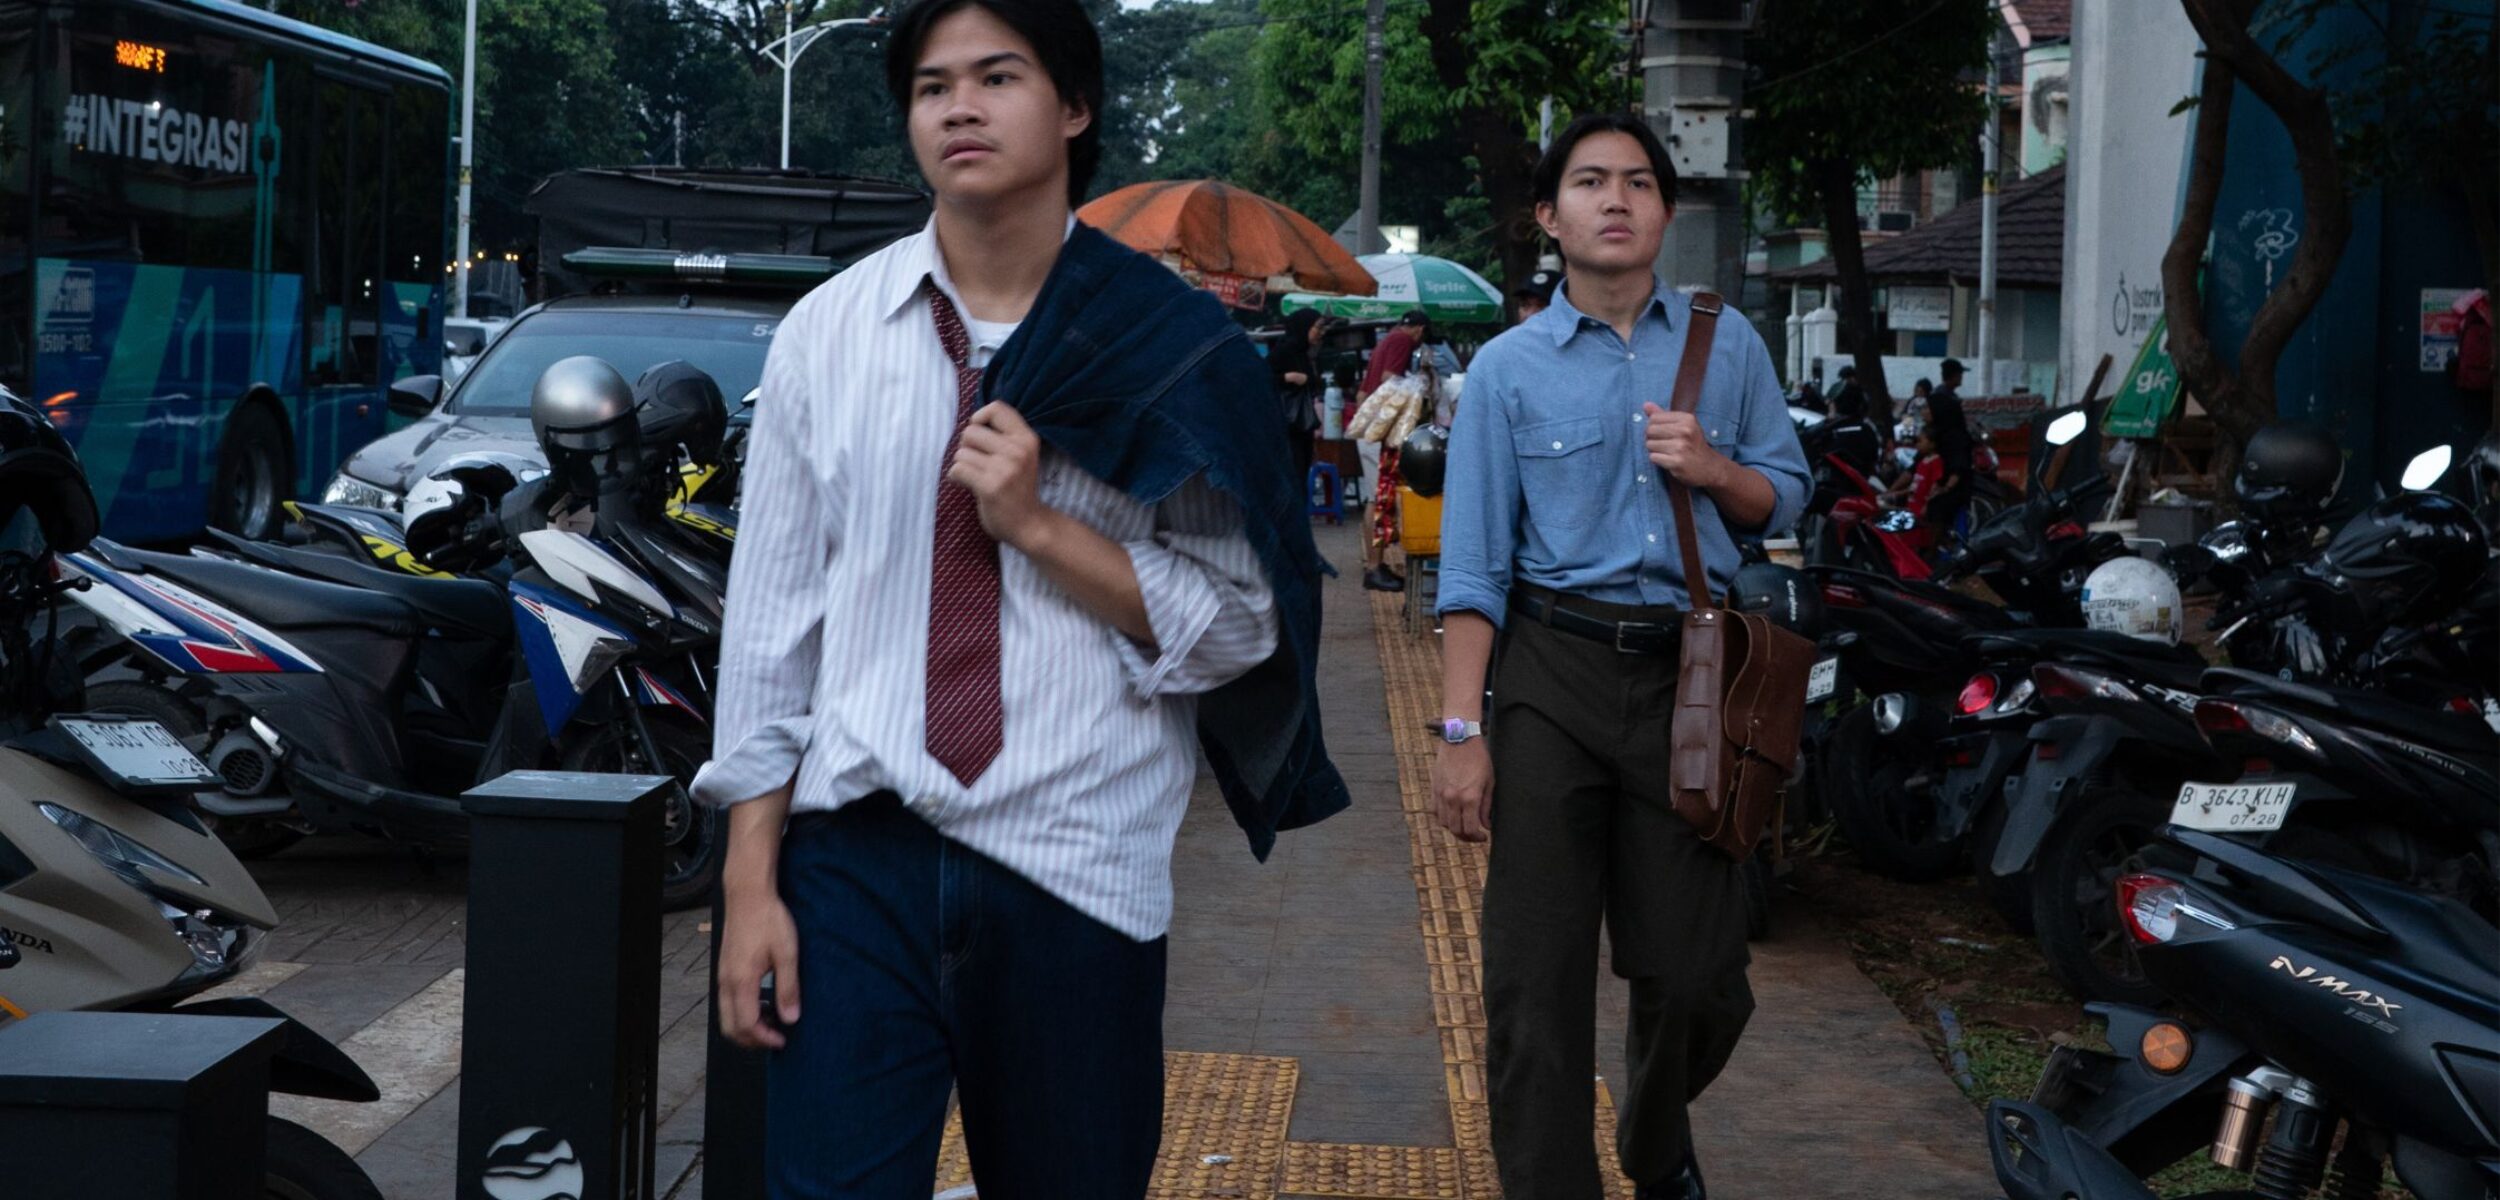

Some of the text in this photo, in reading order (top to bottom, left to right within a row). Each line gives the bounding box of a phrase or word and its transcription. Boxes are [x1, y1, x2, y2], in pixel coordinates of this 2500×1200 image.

[64, 94, 248, 173] #INTEGRASI
[1424, 281, 1468, 294] Sprite
[679, 611, 709, 634] ONDA
[66, 724, 95, 748] B
[2180, 786, 2289, 806] B 3643 KLH
[2269, 955, 2403, 1018] NMAX
[2343, 1007, 2399, 1034] 155
